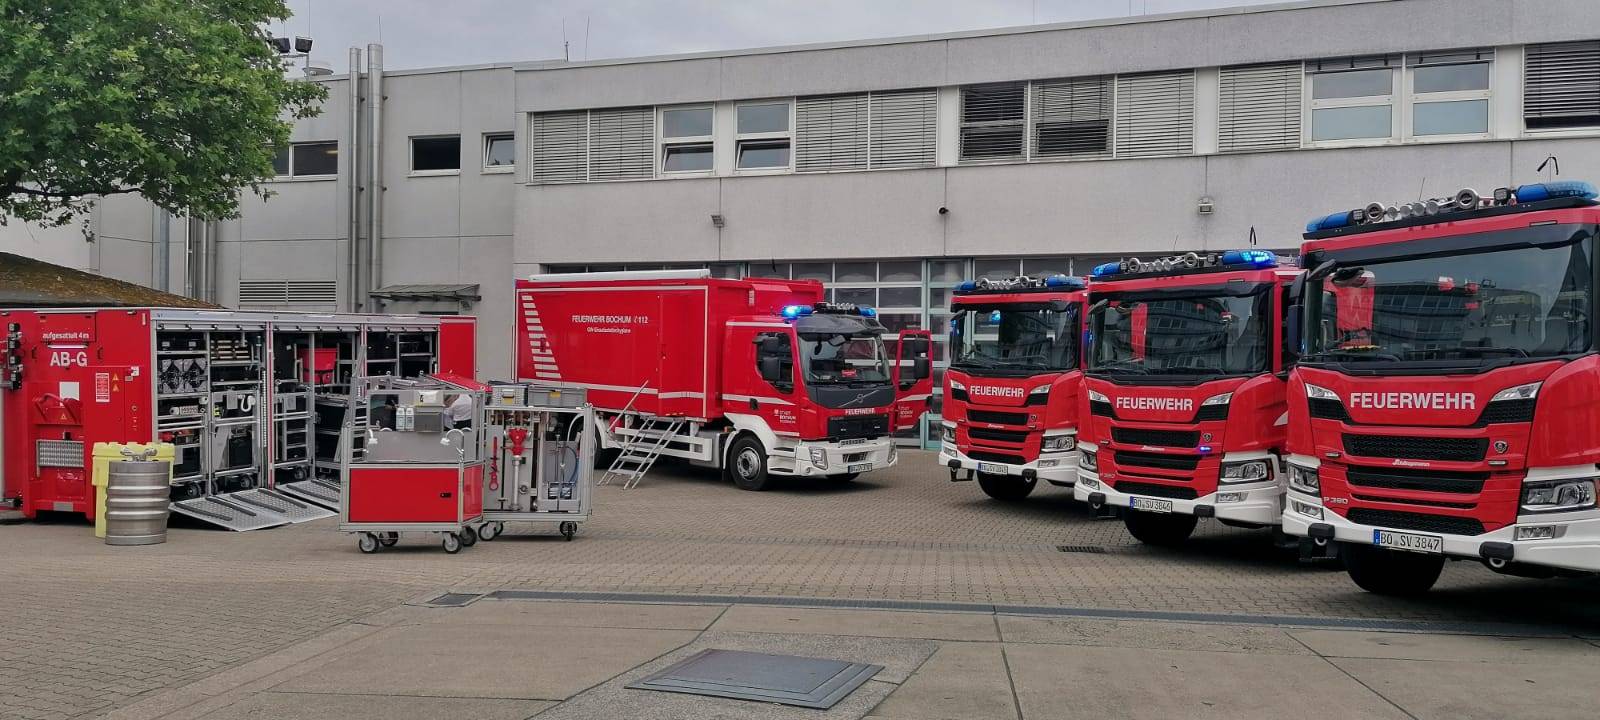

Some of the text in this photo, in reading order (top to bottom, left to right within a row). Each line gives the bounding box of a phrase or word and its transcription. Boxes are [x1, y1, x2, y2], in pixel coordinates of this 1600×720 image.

[606, 315, 632, 324] BOCHUM
[638, 316, 649, 324] 112
[50, 351, 88, 367] AB-G
[970, 385, 1024, 398] FEUERWEHR
[1116, 397, 1193, 411] FEUERWEHR
[1350, 392, 1475, 409] FEUERWEHR
[1380, 532, 1440, 551] BO SV 3847
